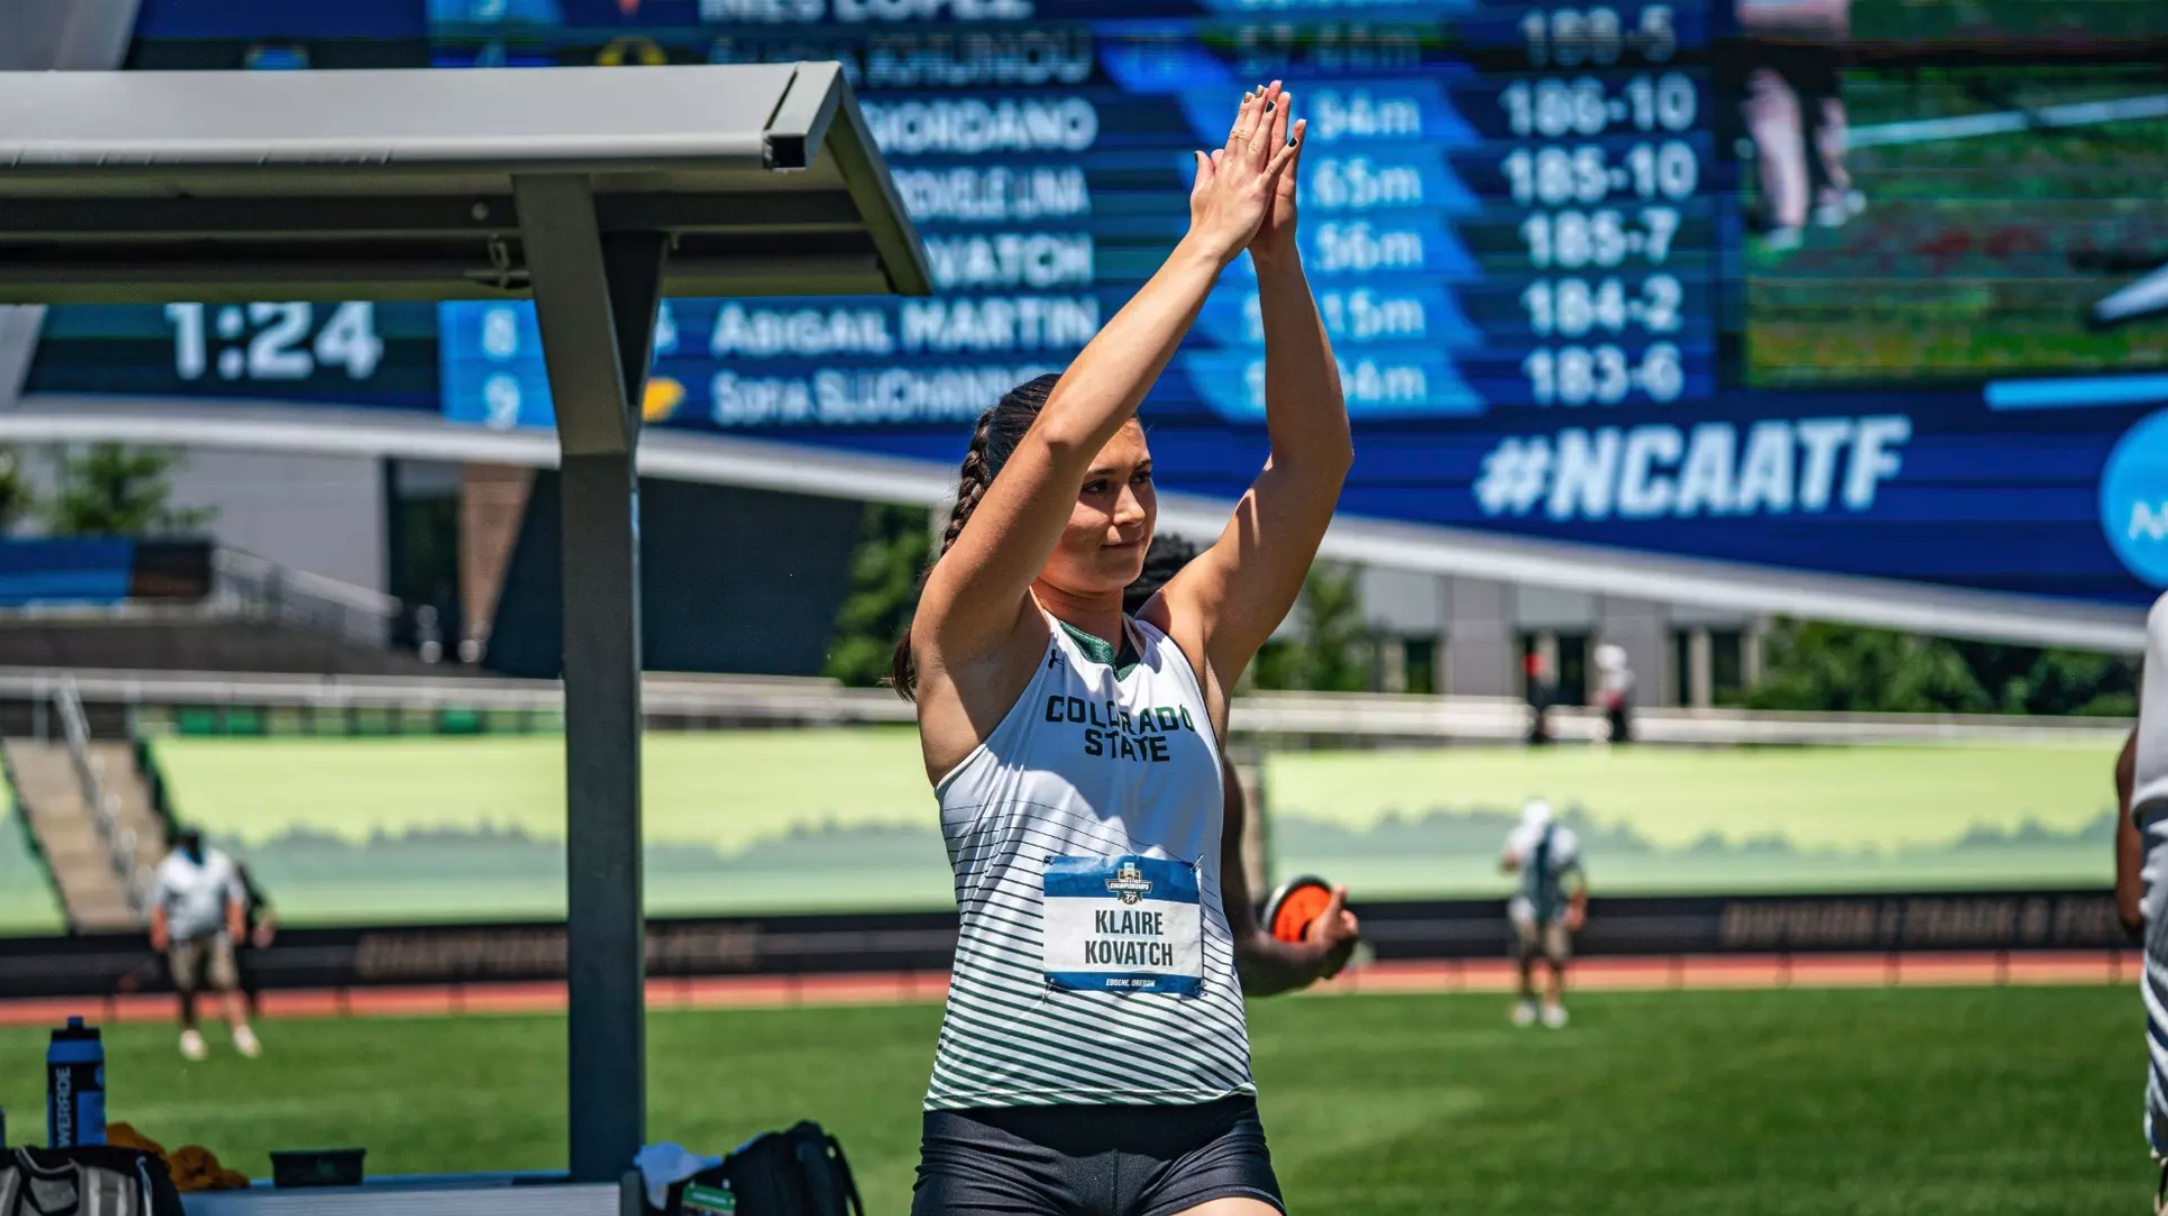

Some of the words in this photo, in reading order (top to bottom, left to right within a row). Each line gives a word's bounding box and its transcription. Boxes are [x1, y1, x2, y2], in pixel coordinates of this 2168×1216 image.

[1502, 74, 1698, 136] 186-10
[1503, 141, 1698, 203] 185-10
[925, 233, 1094, 288] VATCH
[1519, 206, 1682, 270] 185-7
[480, 307, 518, 358] 8
[901, 297, 1099, 350] MARTIN
[1521, 275, 1684, 337] 184-2
[165, 302, 384, 379] 1:24
[484, 375, 520, 428] 9
[1523, 343, 1685, 406] 183-6
[1474, 414, 1913, 520] #NCAATF
[1045, 694, 1196, 736] COLORADO
[1084, 728, 1170, 763] STATE
[1094, 909, 1165, 937] KLAIRE
[1084, 938, 1174, 968] KOVATCH
[56, 1065, 71, 1148] WERADE
